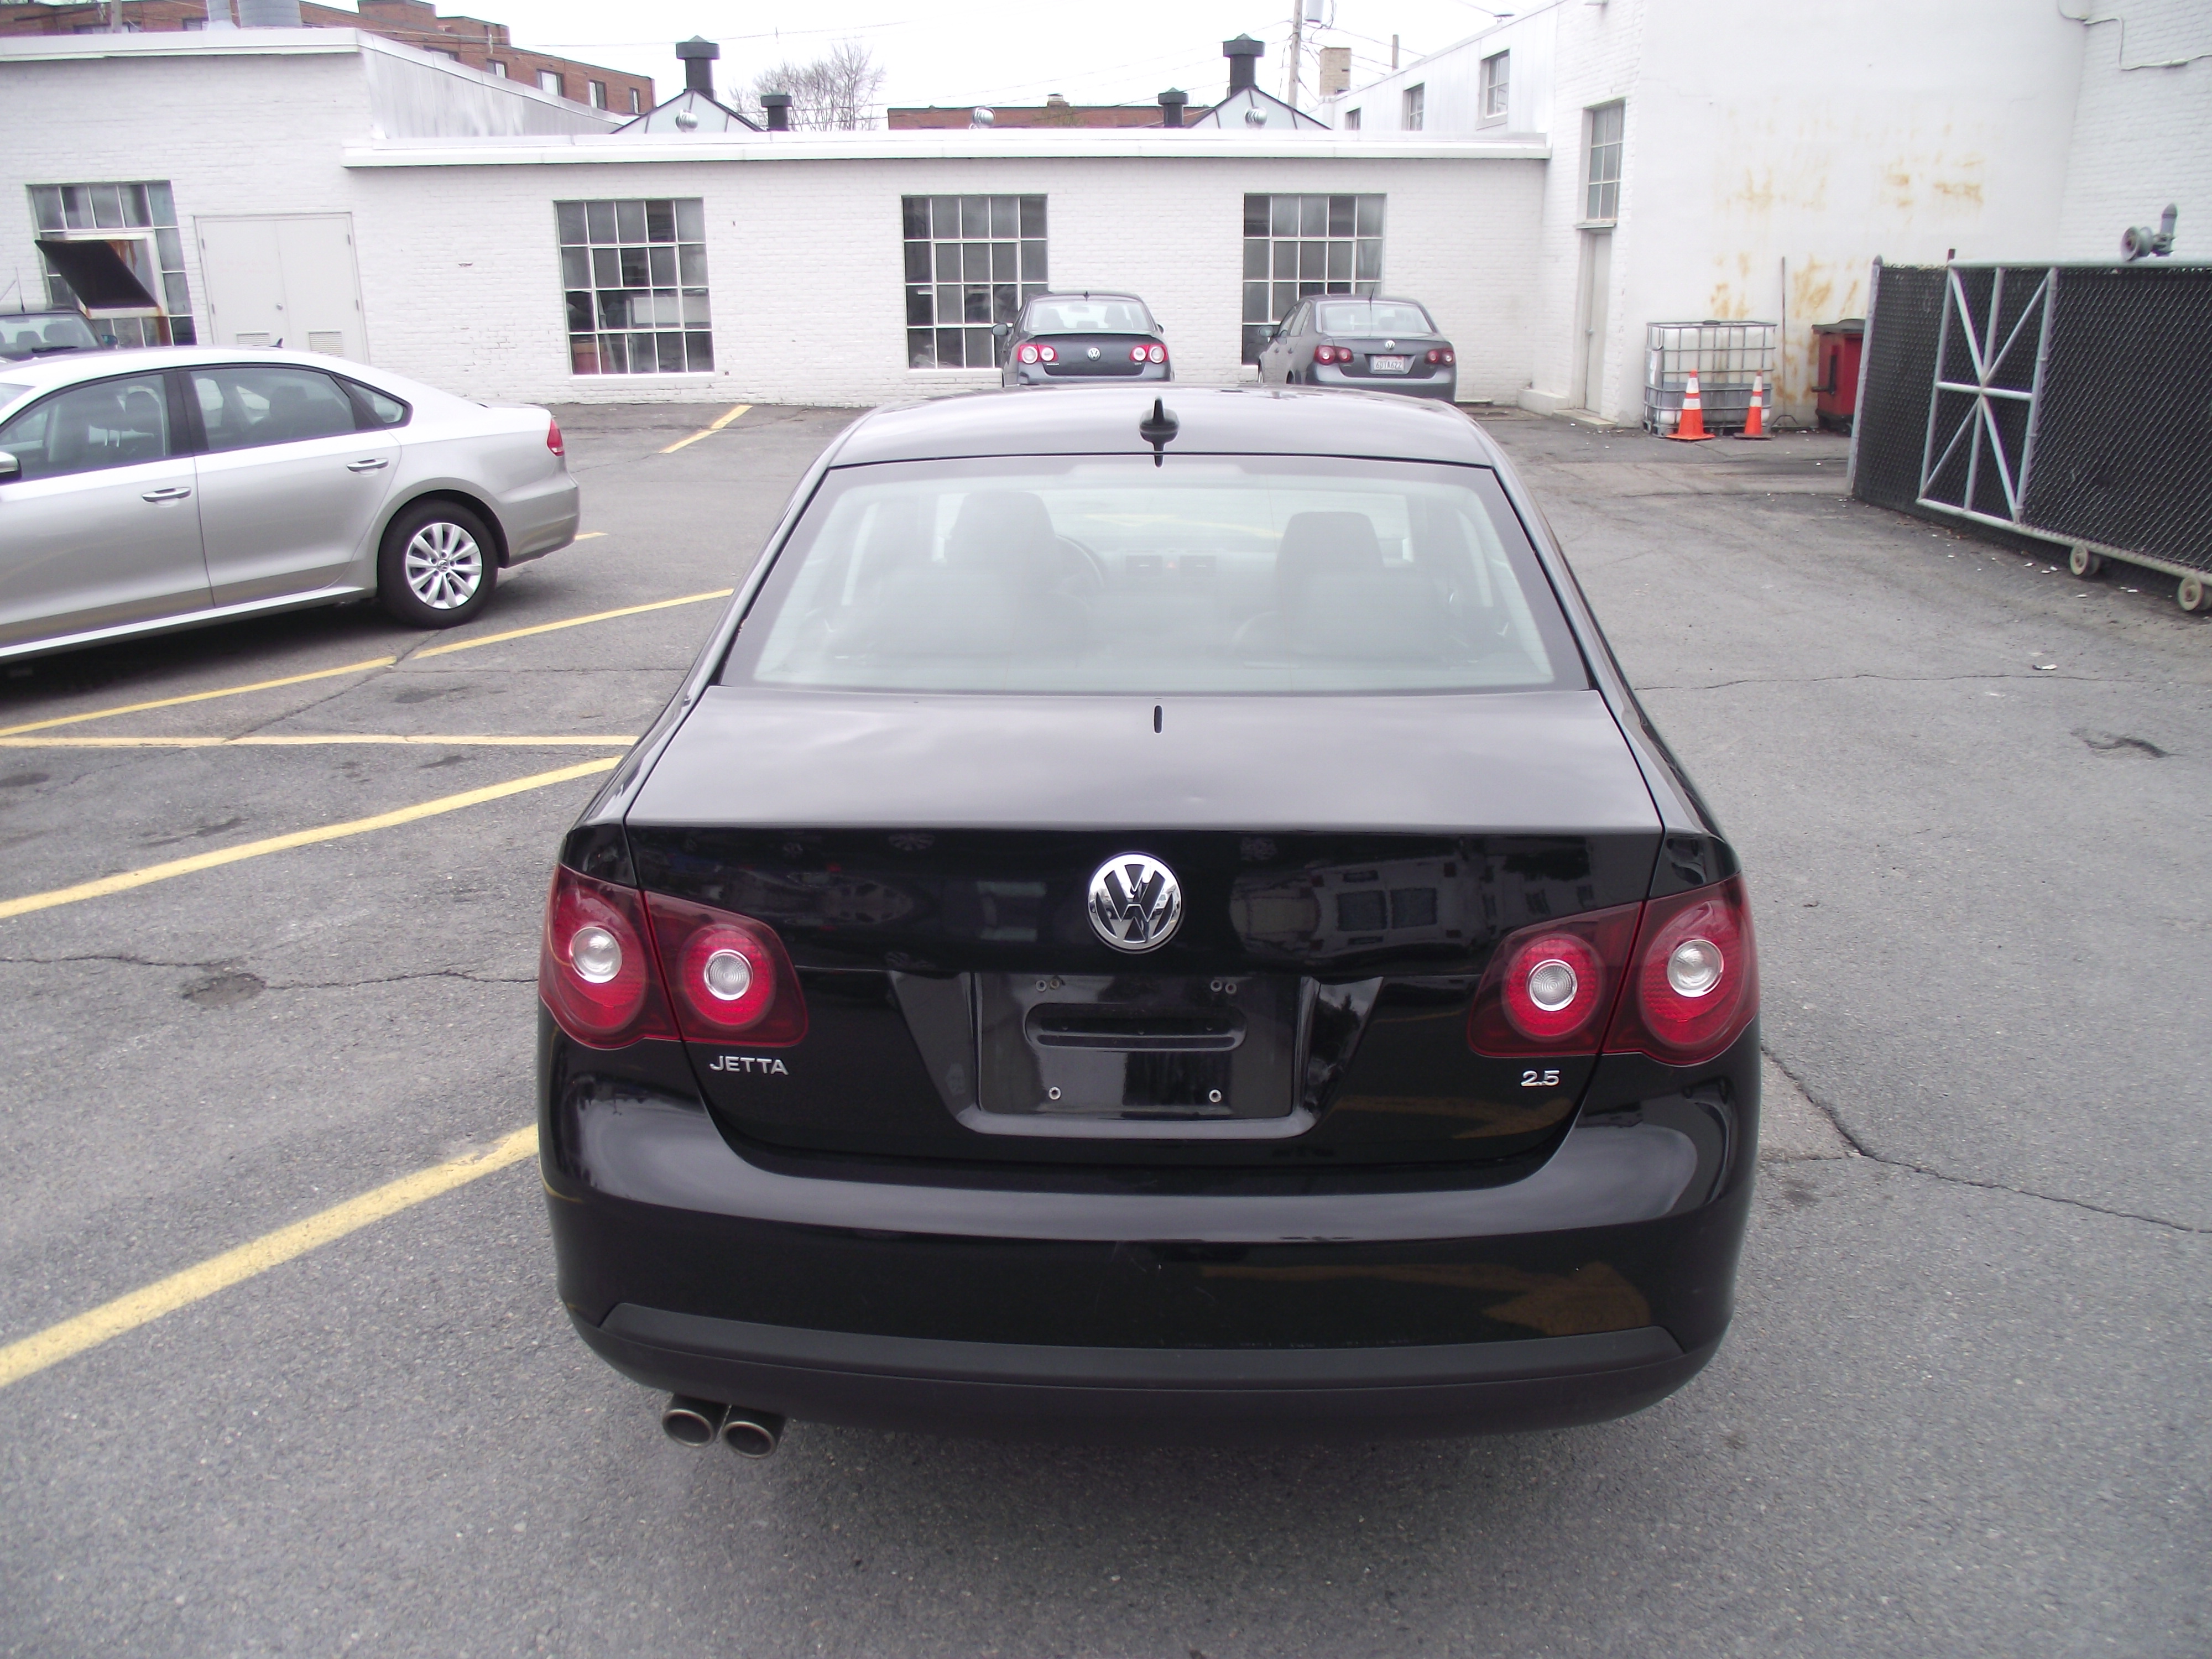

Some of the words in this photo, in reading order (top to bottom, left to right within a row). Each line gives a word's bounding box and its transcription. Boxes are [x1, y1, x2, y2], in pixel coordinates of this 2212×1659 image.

[1089, 855, 1181, 949] VW
[709, 1056, 789, 1075] JETTA
[1521, 1070, 1559, 1087] 2.5
